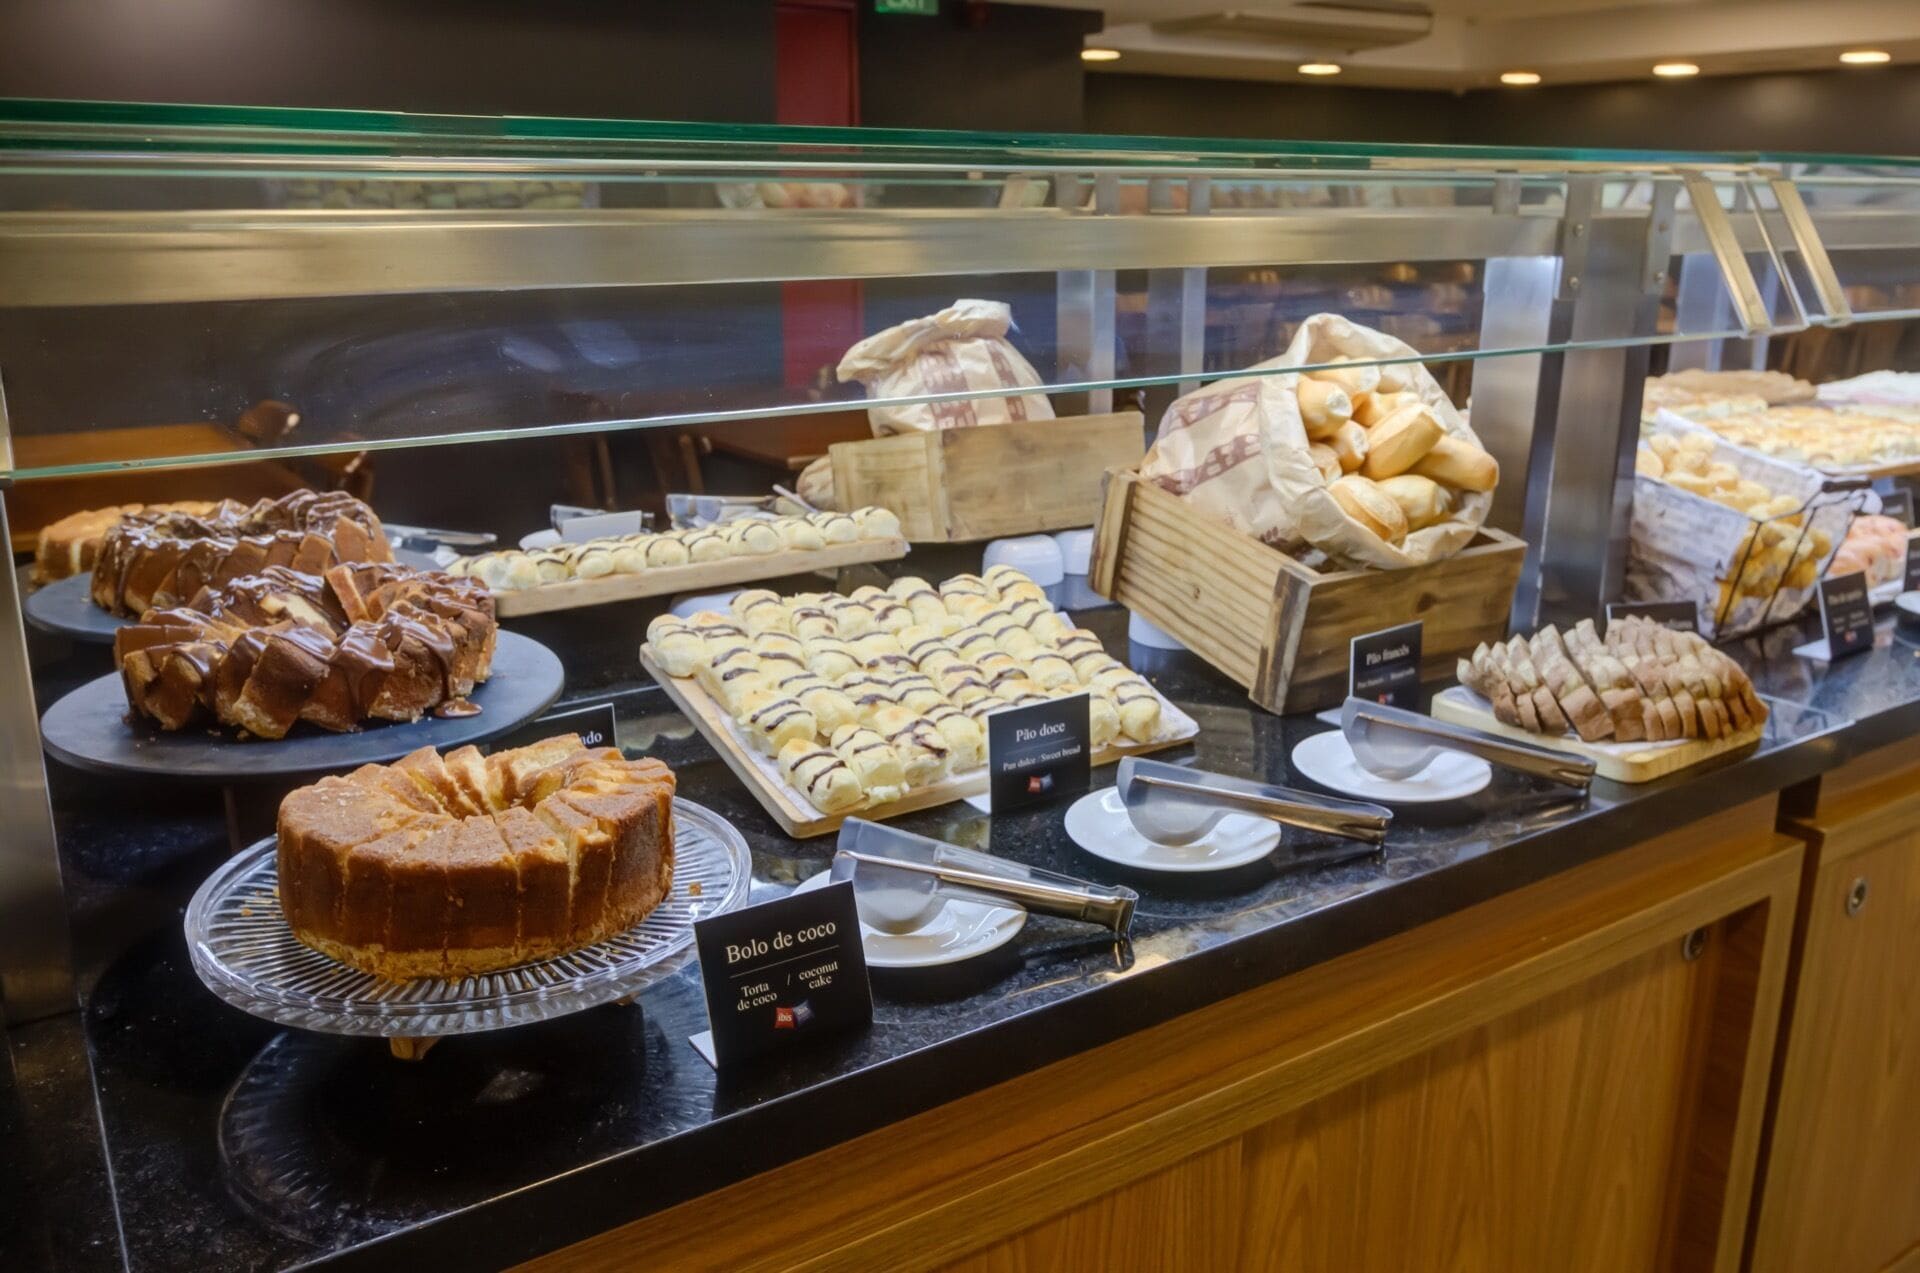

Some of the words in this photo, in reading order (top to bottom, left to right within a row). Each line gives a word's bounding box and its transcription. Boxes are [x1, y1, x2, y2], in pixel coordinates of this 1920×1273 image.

[1015, 728, 1037, 742] Pão
[1039, 722, 1066, 737] doce
[725, 939, 769, 964] Bolo
[773, 931, 794, 951] de
[797, 921, 837, 943] coco
[798, 961, 839, 981] coconut
[740, 981, 770, 998] Torta
[808, 974, 833, 990] cake
[737, 999, 750, 1012] de
[752, 992, 778, 1007] coco
